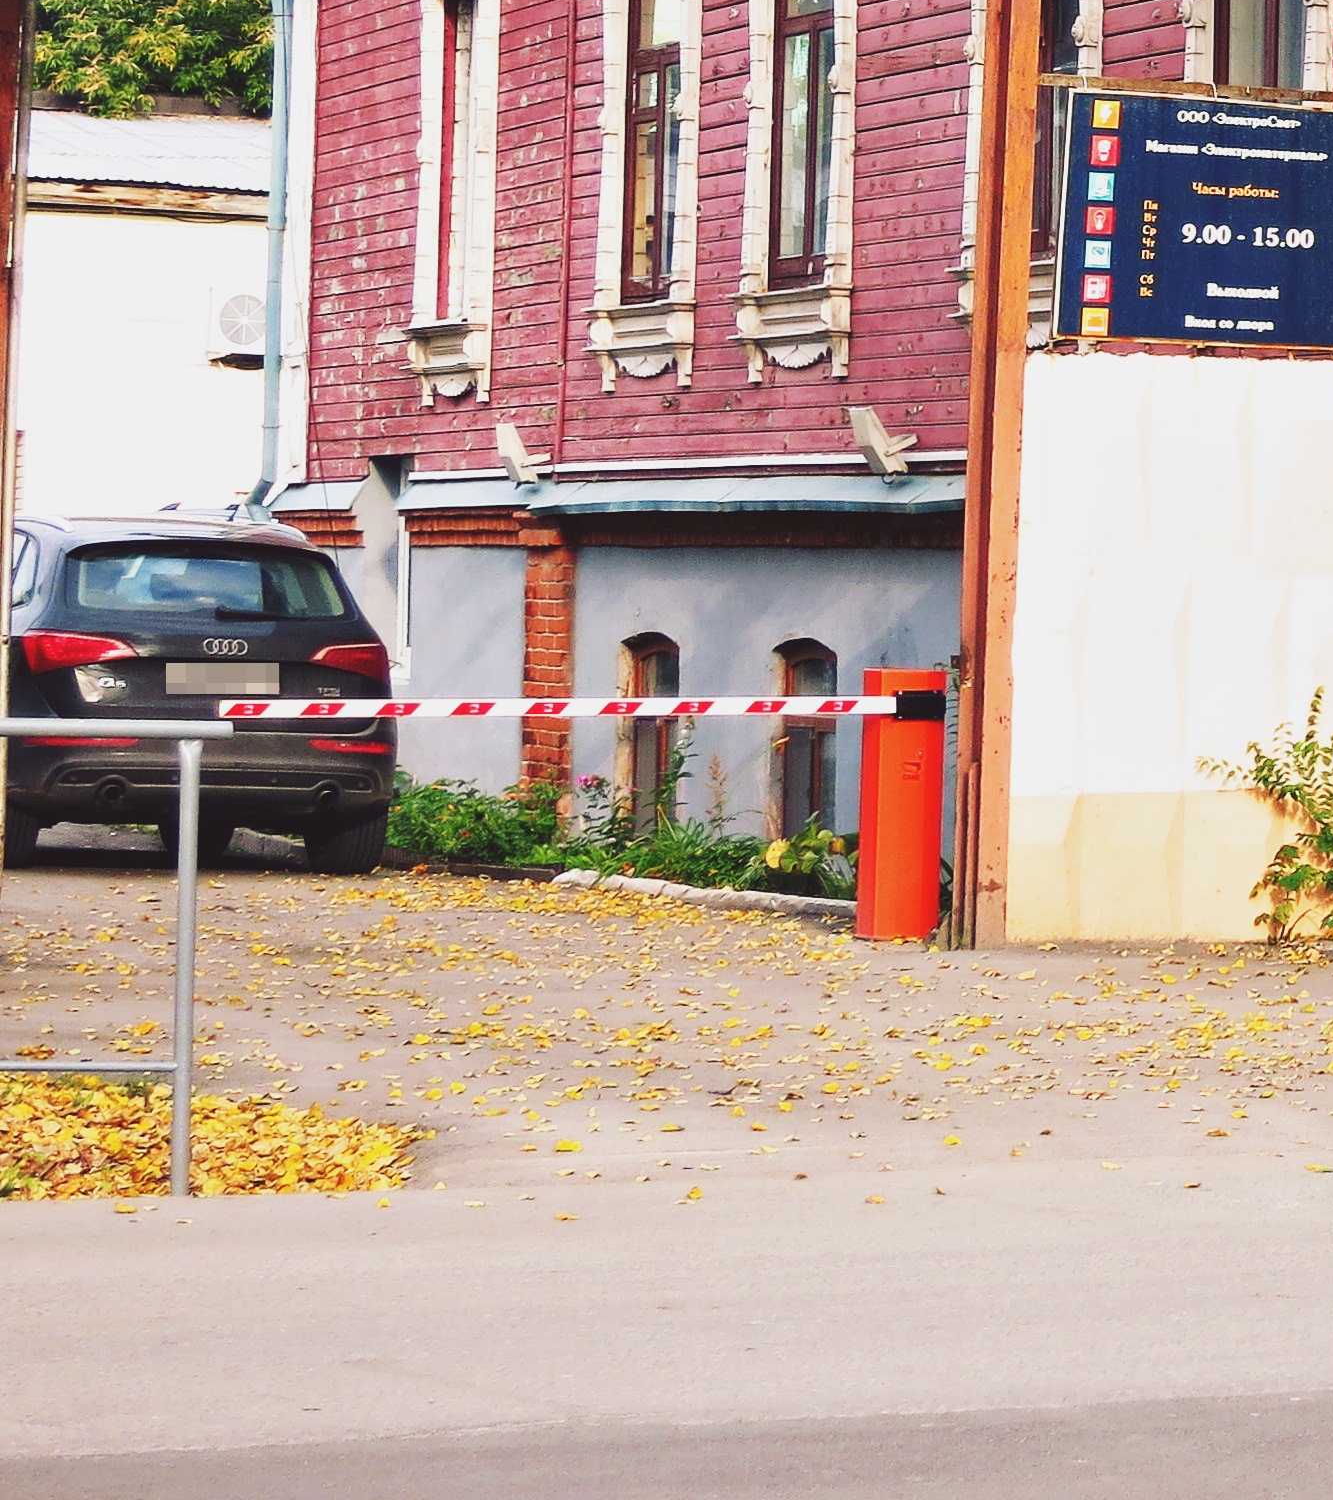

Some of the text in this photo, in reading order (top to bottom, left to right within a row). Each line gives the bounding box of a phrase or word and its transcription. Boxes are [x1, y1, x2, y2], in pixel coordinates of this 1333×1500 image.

[1177, 110, 1210, 123] ООО
[1145, 140, 1198, 154] Магазин
[1192, 182, 1280, 198] Часы работы:
[1143, 200, 1159, 211] Пн
[1143, 213, 1157, 222] Вт
[1142, 225, 1157, 236] Ср
[1181, 223, 1232, 245] 9.00
[1252, 226, 1315, 249] 15.00
[1142, 238, 1156, 248] Чт
[1141, 250, 1155, 260] Пт
[1139, 274, 1154, 285] Сб
[1139, 287, 1153, 297] Вс
[1206, 282, 1280, 300] Выходной
[1184, 315, 1275, 332] Вход со двора
